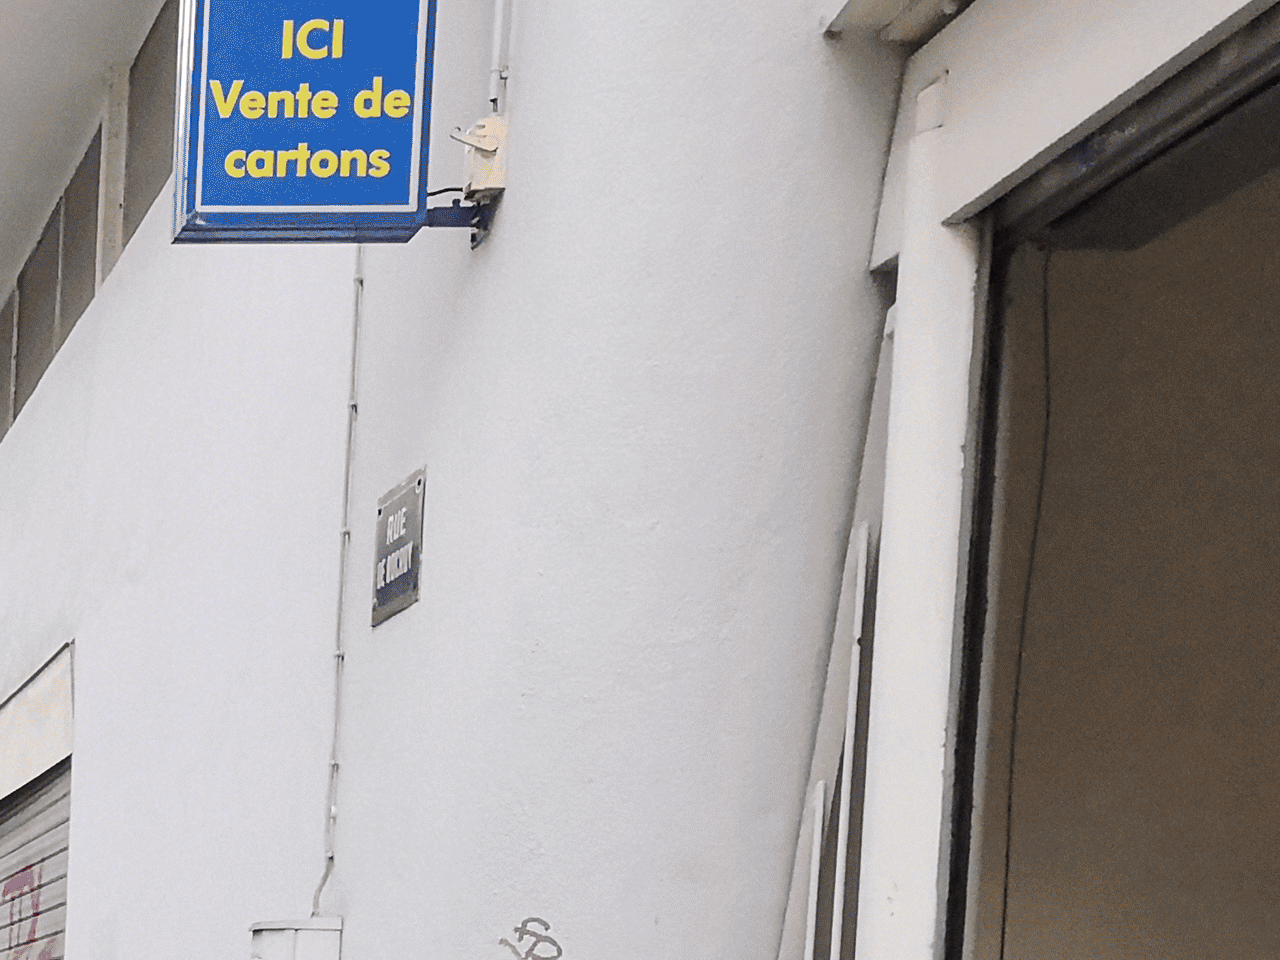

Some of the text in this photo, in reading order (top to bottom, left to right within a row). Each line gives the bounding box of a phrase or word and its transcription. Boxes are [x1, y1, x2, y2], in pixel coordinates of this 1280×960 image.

[282, 19, 345, 59] ICI
[209, 76, 411, 119] Vente de
[224, 142, 391, 178] cartons
[386, 507, 407, 545] RUE
